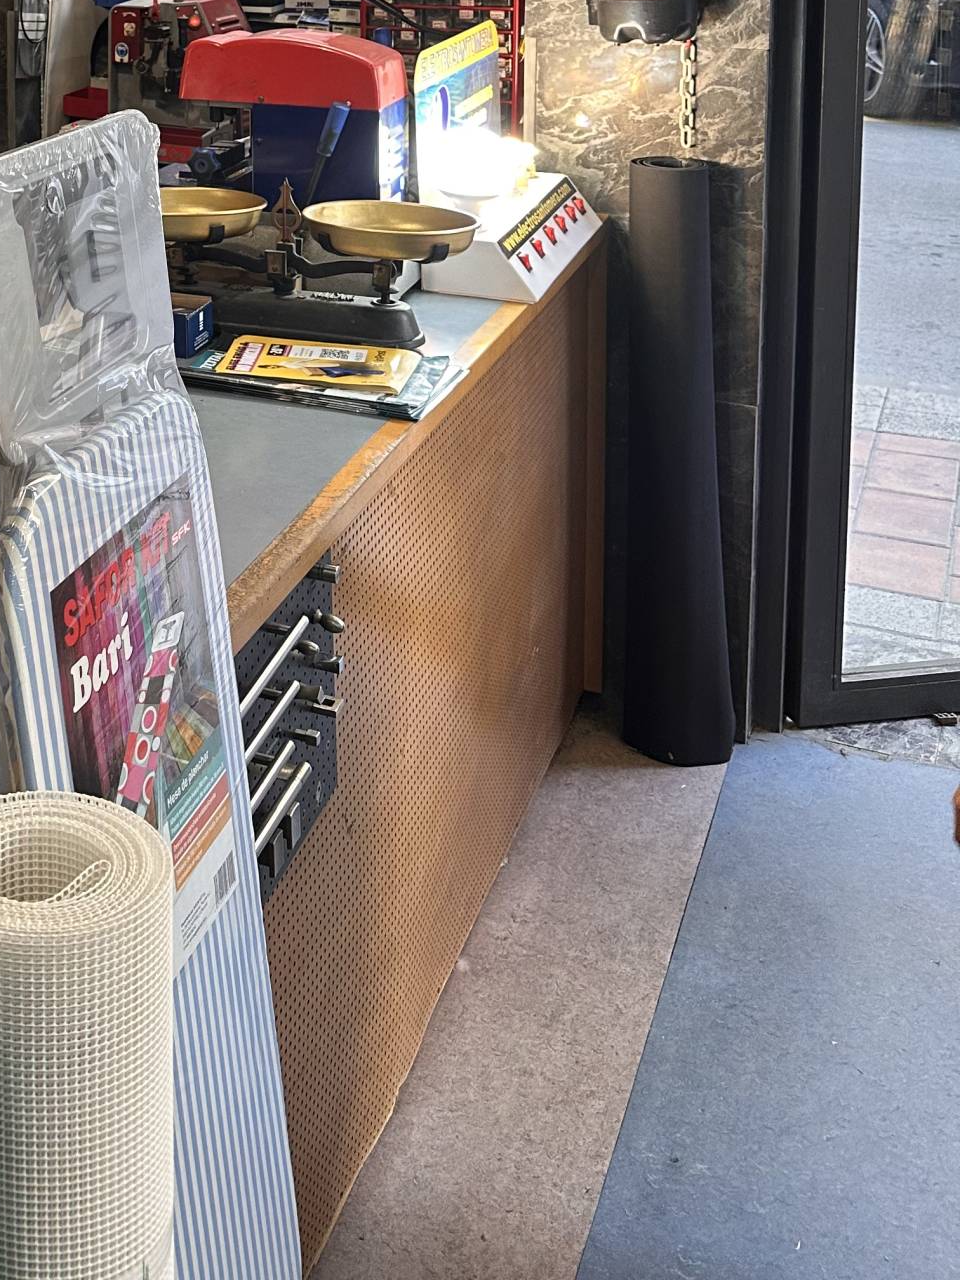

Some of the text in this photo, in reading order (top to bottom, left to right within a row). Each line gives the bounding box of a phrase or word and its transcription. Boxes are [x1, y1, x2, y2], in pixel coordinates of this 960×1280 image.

[172, 520, 190, 546] SFK
[64, 546, 136, 647] SAFOR
[71, 612, 133, 714] Bari
[167, 750, 209, 808] Mesa de planchar
